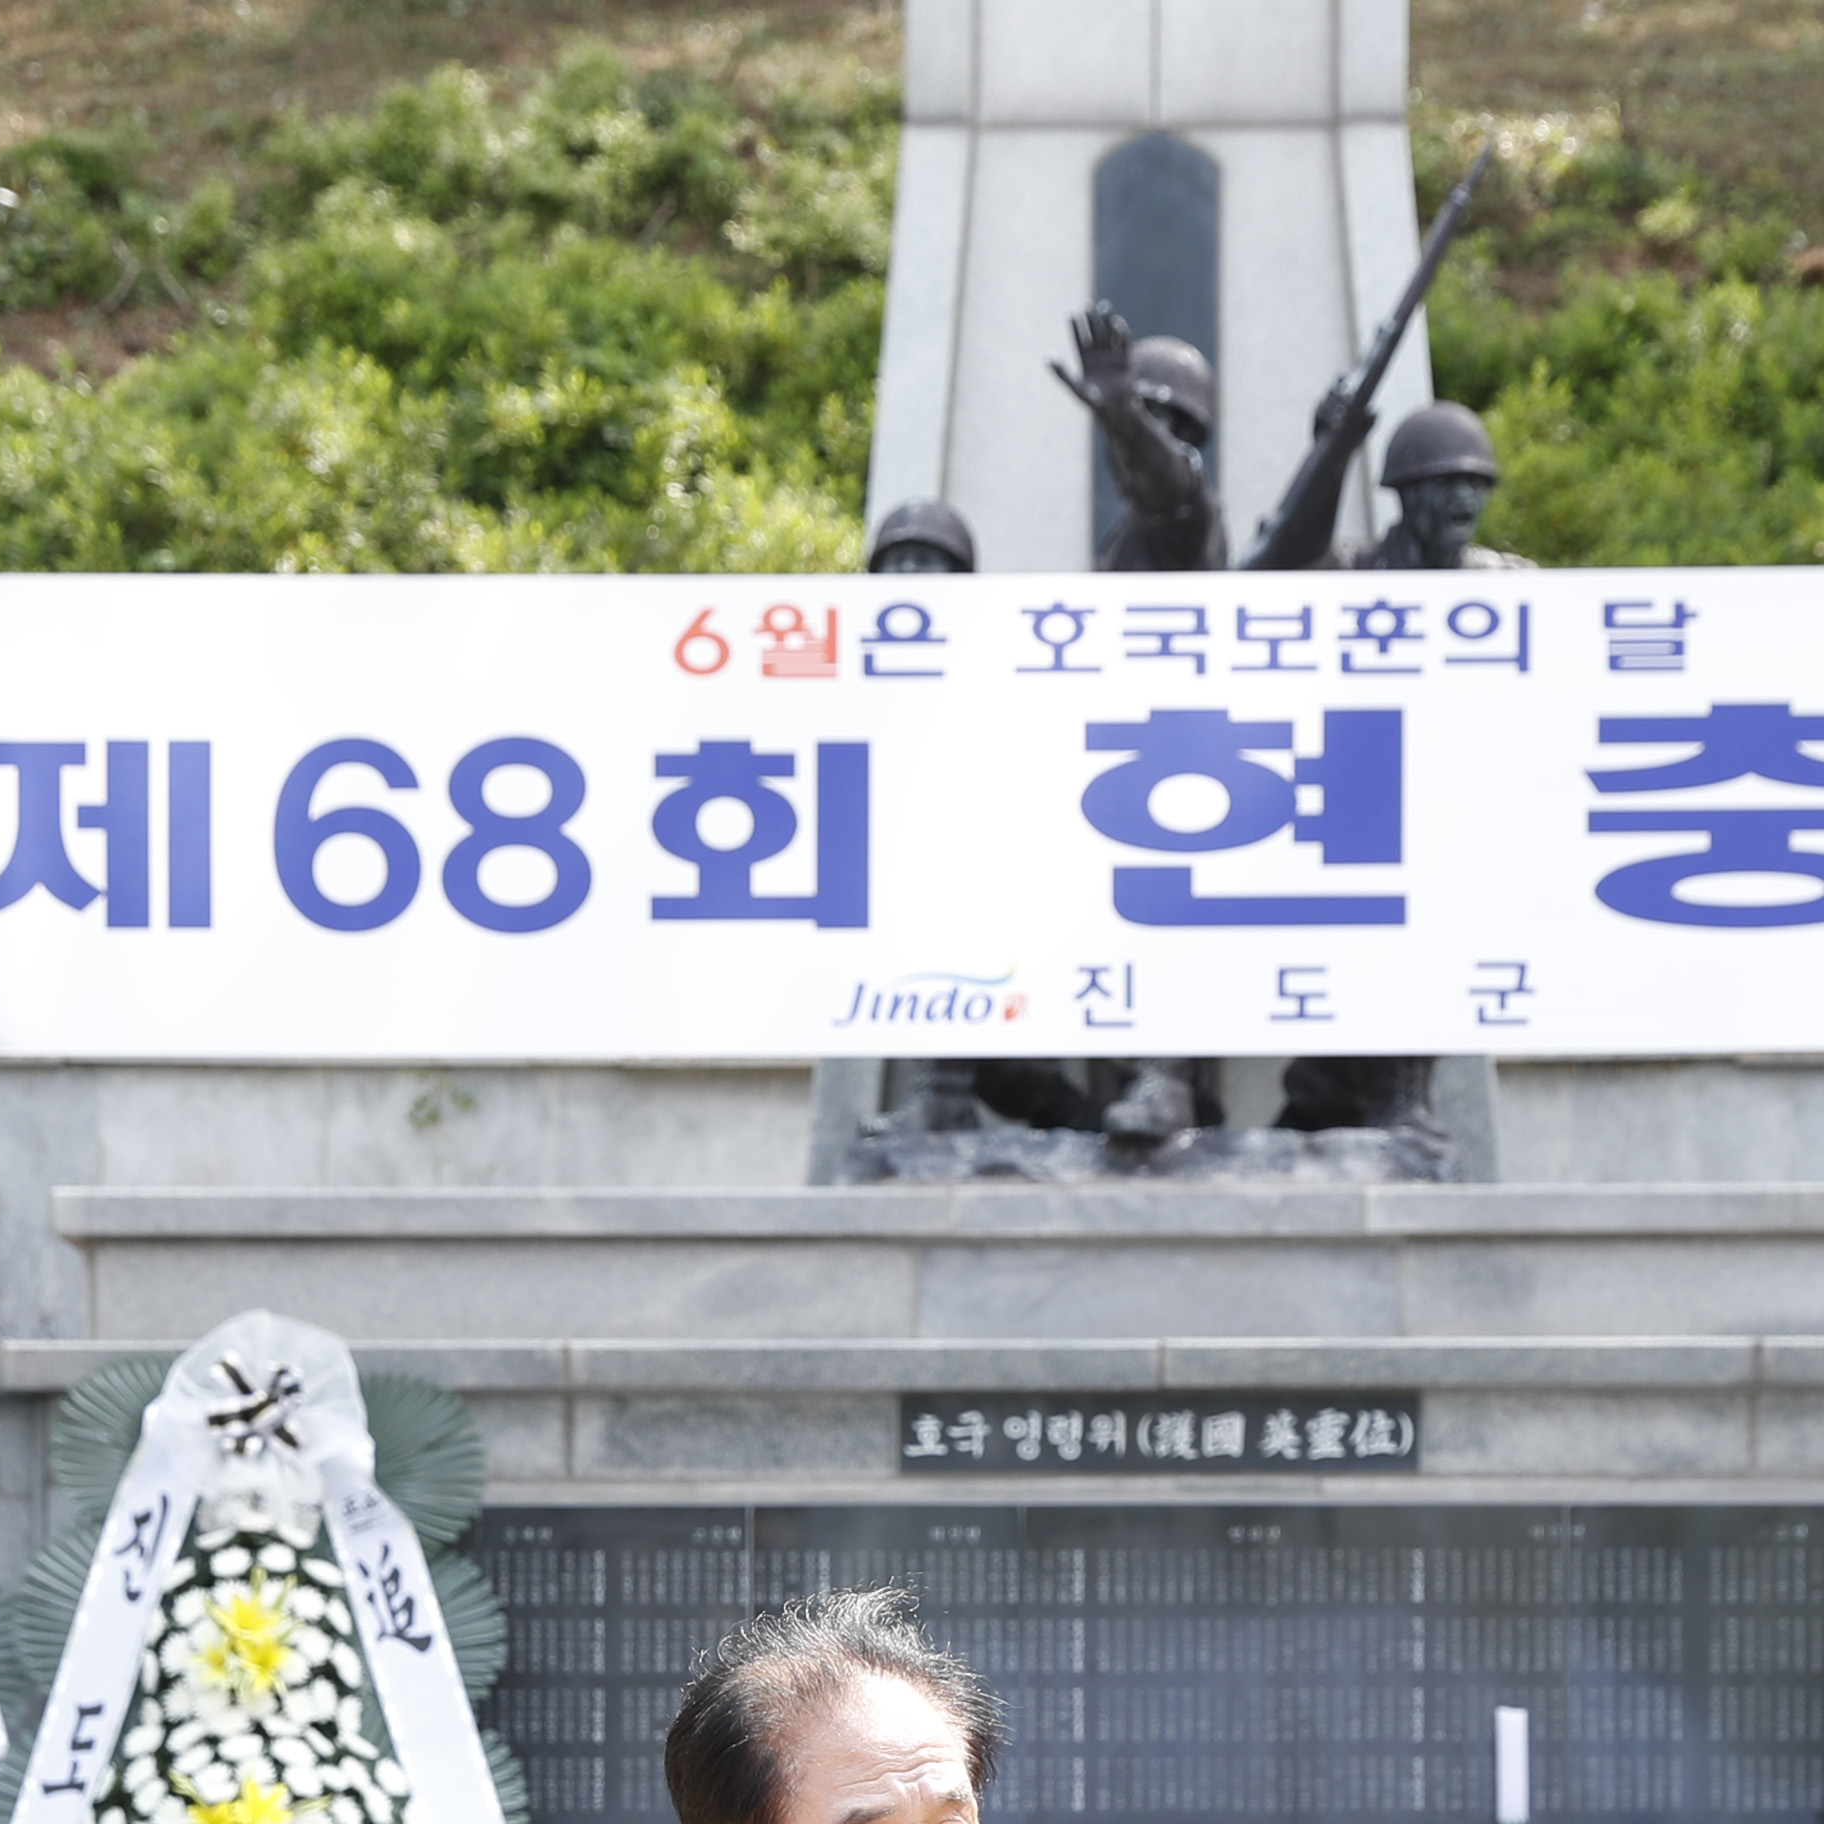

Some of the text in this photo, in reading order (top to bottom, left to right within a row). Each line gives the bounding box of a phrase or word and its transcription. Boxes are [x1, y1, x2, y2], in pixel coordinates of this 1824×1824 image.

[672, 598, 1700, 680] 6월은 호국보훈의 달
[833, 982, 994, 1026] Jindo
[1073, 959, 1537, 1031] 진도군
[903, 1410, 992, 1459] 호국
